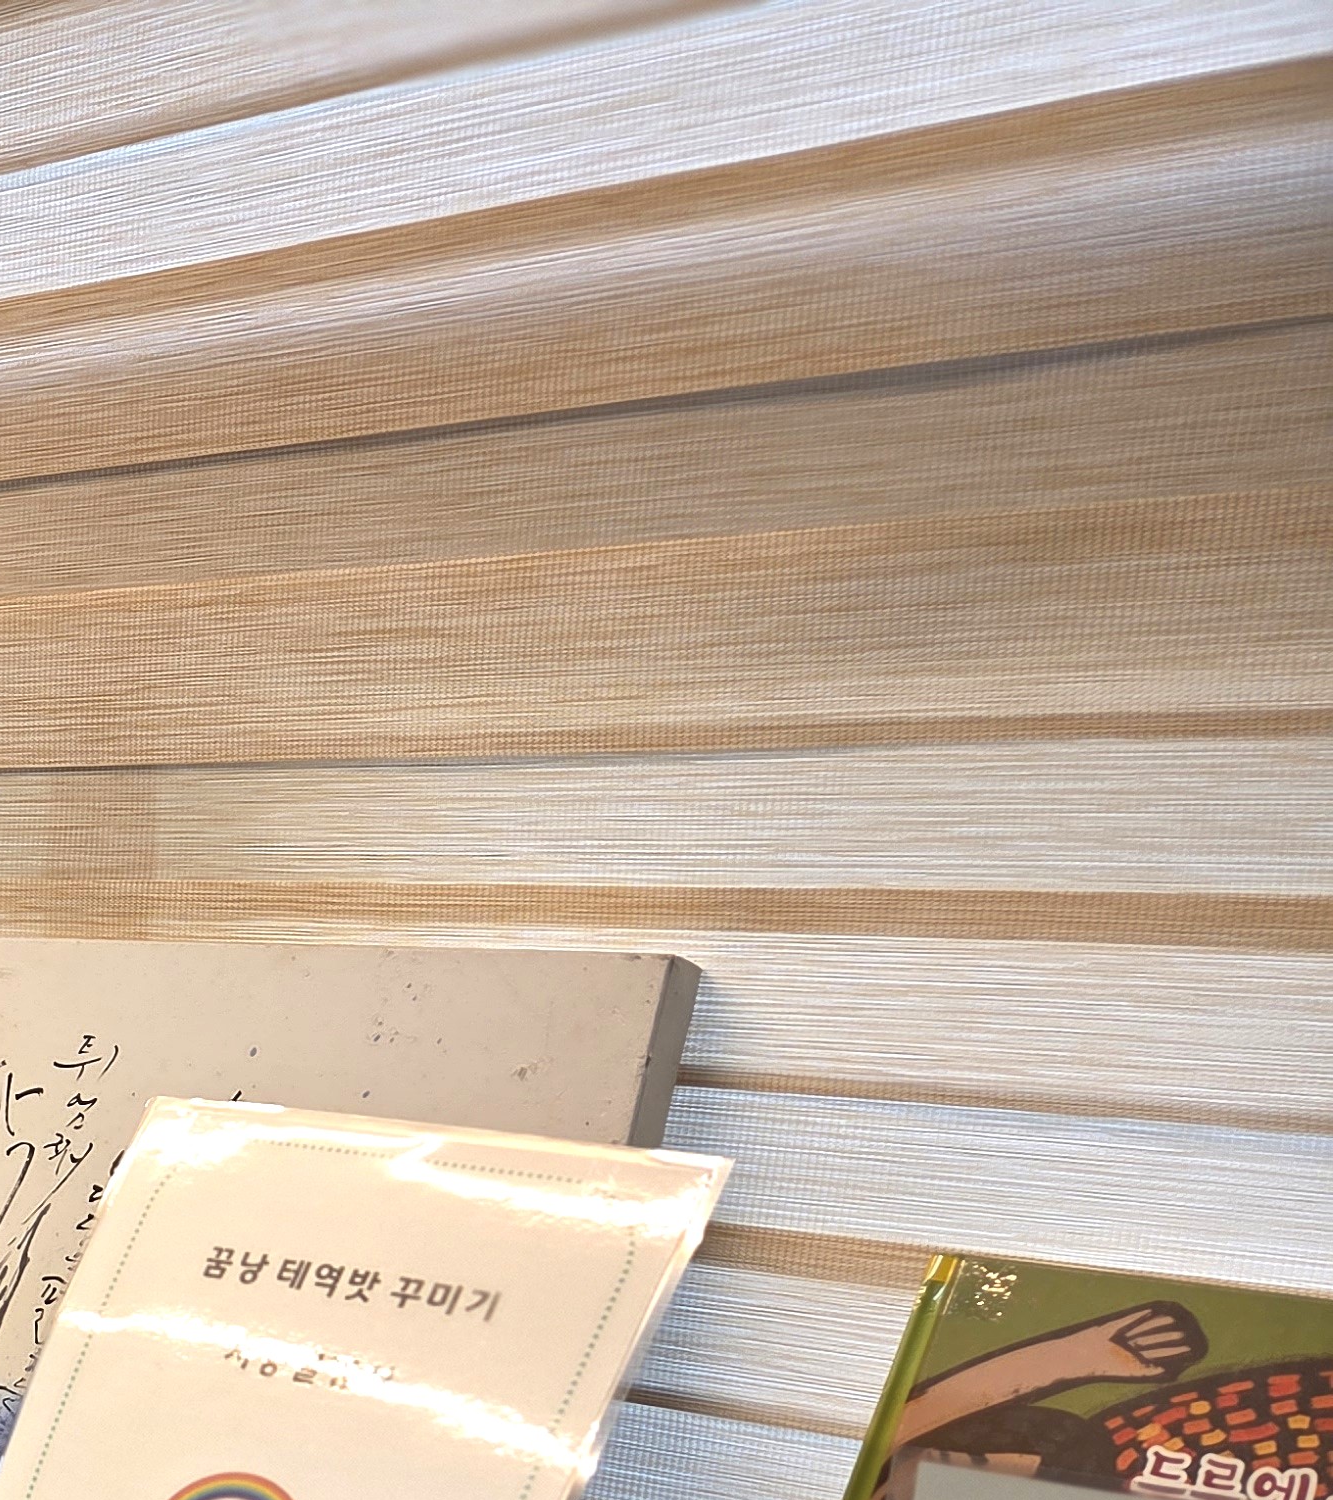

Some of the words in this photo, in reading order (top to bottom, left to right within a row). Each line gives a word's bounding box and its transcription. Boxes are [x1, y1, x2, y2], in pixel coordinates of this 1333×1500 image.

[202, 1244, 270, 1286] 꿈낭
[276, 1257, 382, 1304] 테역밧
[389, 1275, 503, 1323] 꾸미기
